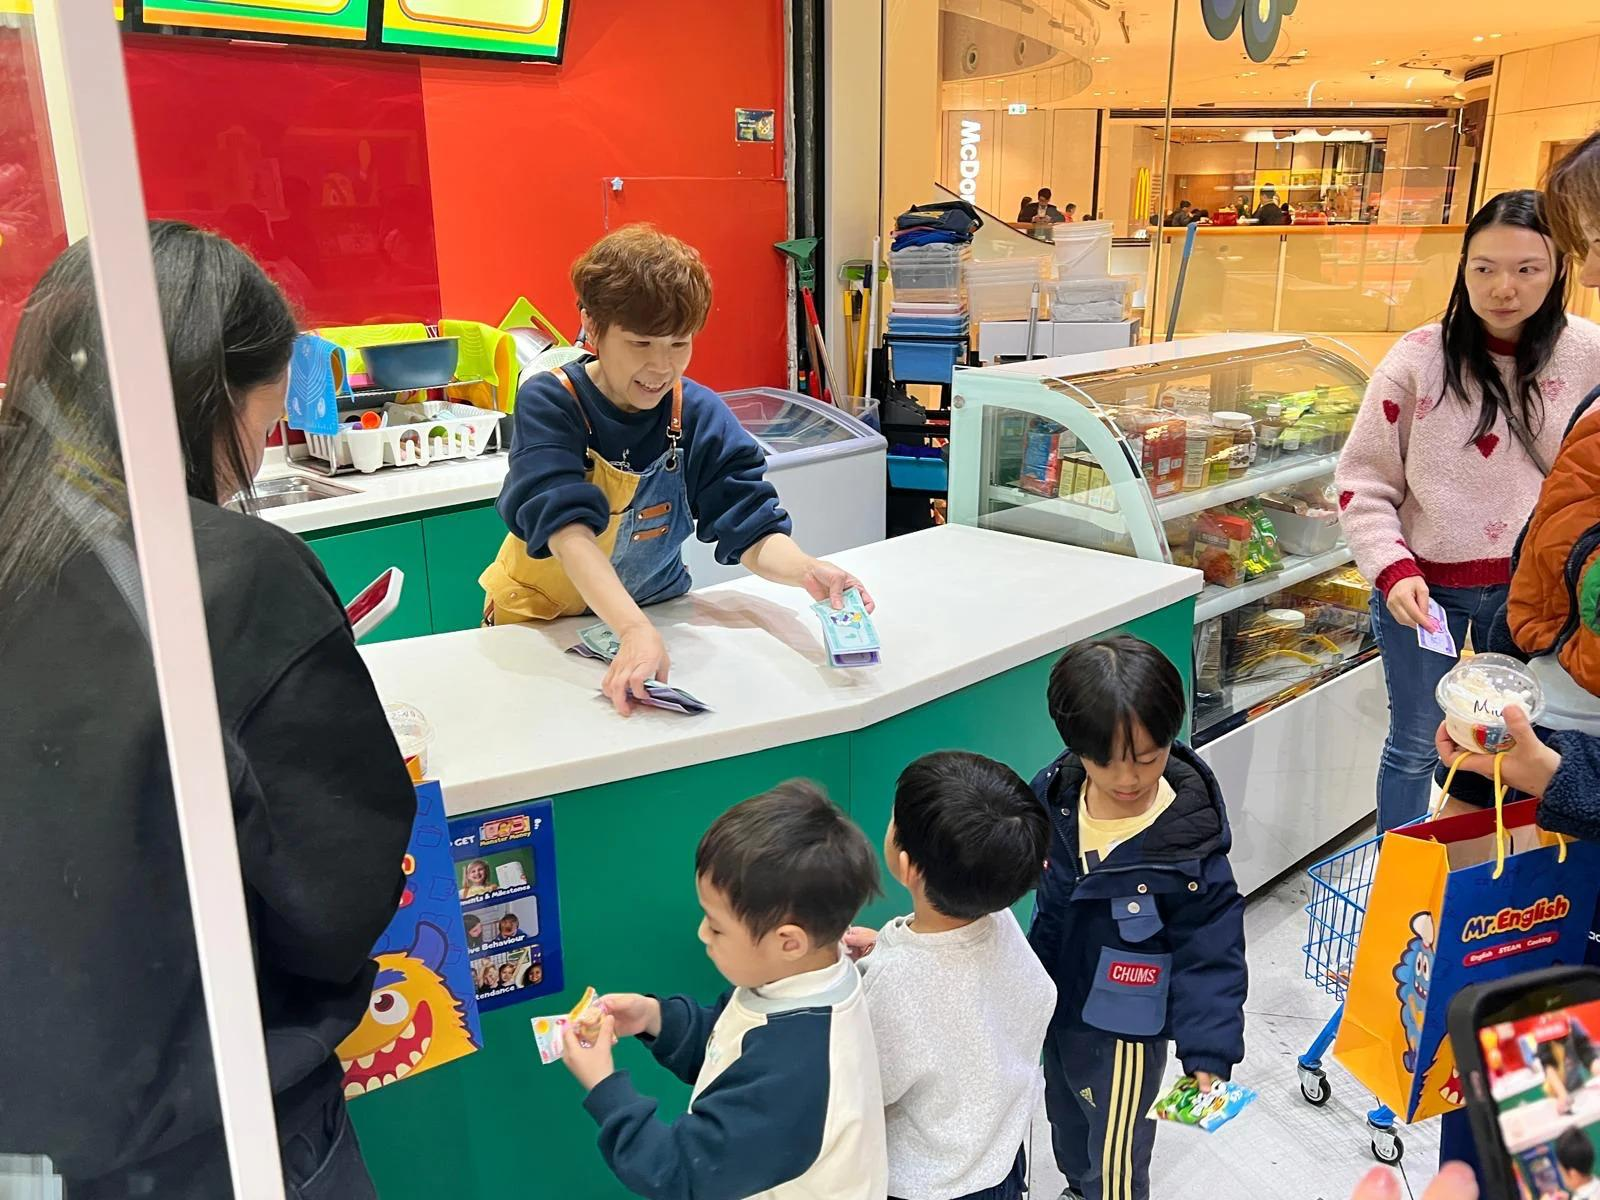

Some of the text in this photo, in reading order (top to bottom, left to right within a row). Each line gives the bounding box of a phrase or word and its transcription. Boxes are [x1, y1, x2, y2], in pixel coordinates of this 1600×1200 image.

[454, 835, 475, 846] GET
[491, 885, 531, 898] Milestones
[481, 935, 525, 951] Behaviour
[1470, 937, 1552, 962] English STEAM Cooking
[1112, 965, 1156, 983] CHUMS
